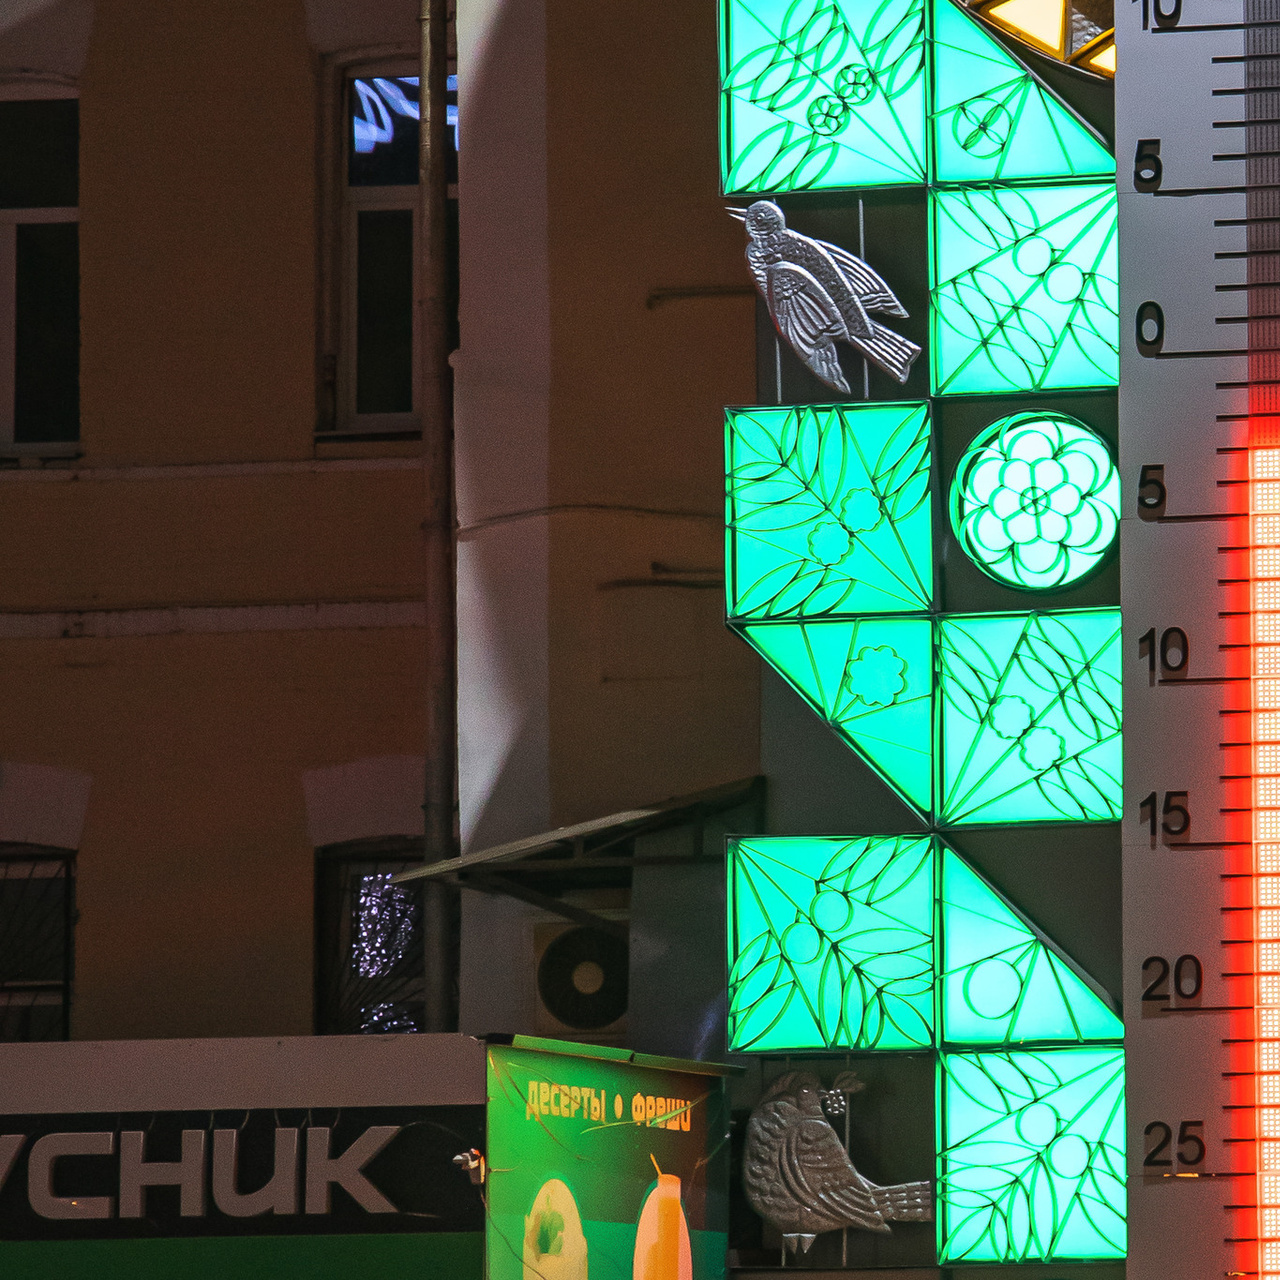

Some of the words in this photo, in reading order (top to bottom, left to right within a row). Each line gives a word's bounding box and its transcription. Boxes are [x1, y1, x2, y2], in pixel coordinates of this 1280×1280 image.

[1134, 138, 1161, 188] 5
[1136, 301, 1162, 346] 0
[1139, 464, 1166, 510] 5
[1139, 627, 1187, 674] 10
[1139, 791, 1189, 837] 15
[1142, 955, 1201, 1001] 20
[1143, 1121, 1206, 1166] 25
